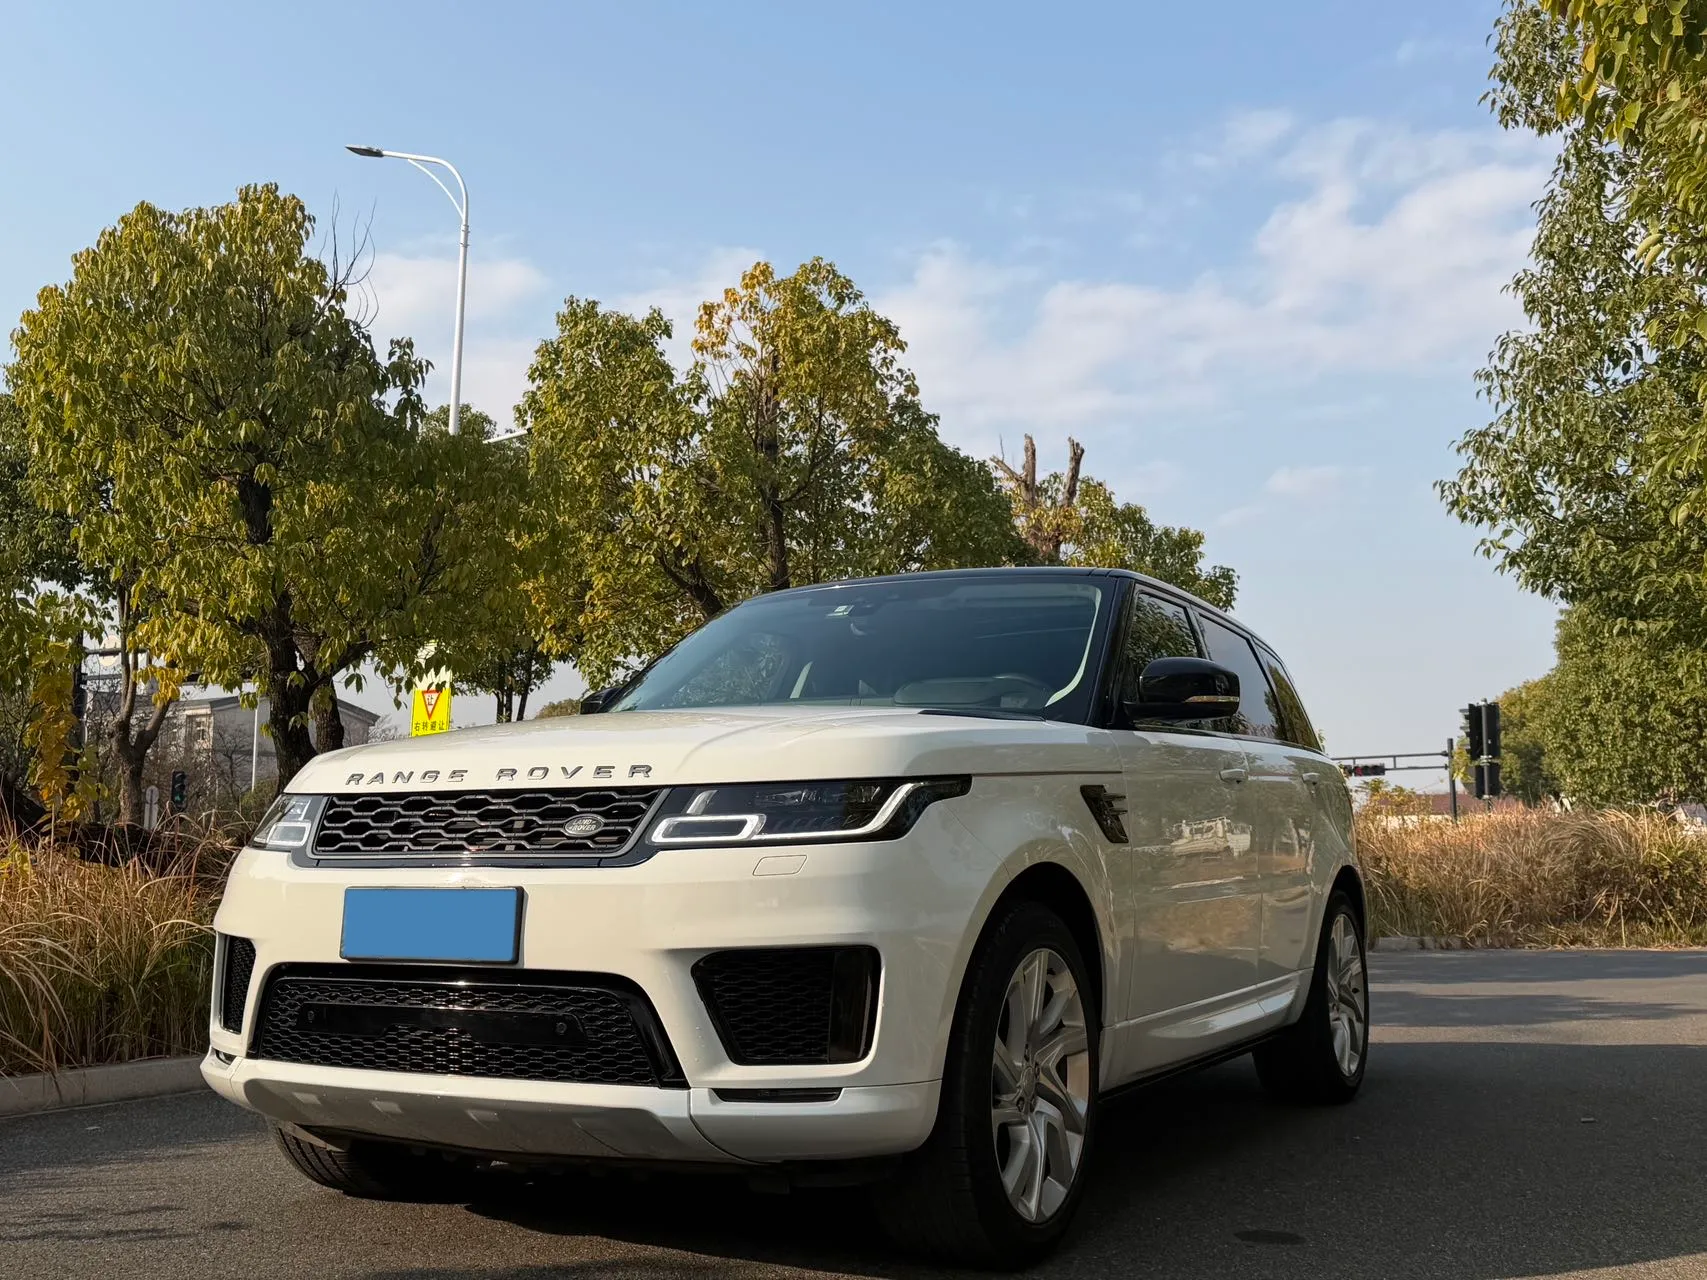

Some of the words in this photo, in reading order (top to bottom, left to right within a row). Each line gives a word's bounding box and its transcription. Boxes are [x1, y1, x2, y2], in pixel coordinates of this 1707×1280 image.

[427, 695, 434, 706] 让
[345, 769, 469, 785] RANGE
[495, 764, 652, 781] ROVER
